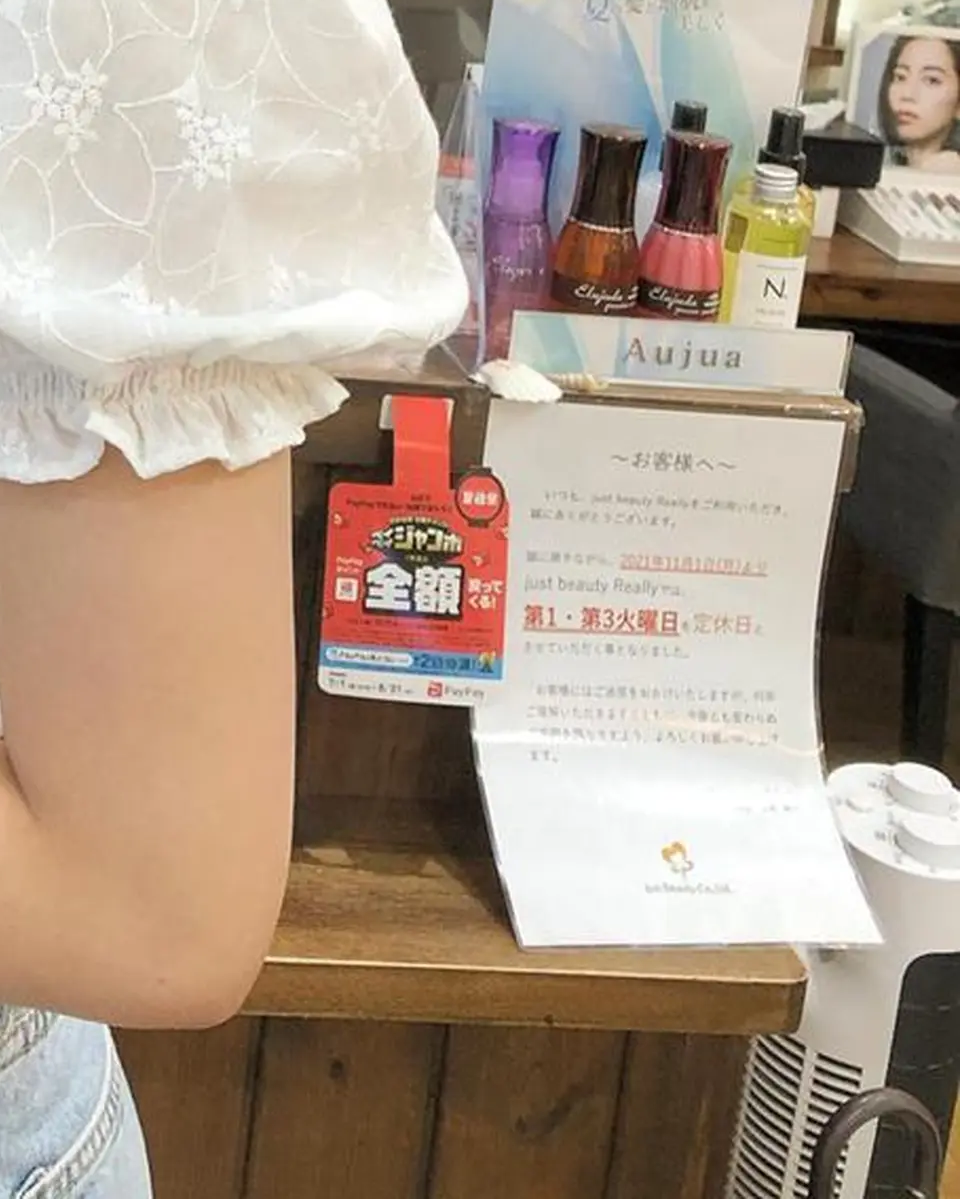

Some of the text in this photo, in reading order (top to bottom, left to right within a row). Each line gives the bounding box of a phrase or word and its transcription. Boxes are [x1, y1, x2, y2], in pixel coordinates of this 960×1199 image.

[624, 337, 743, 371] Aujua
[365, 561, 463, 615] 全額
[524, 577, 553, 592] just
[558, 577, 608, 593] beauty
